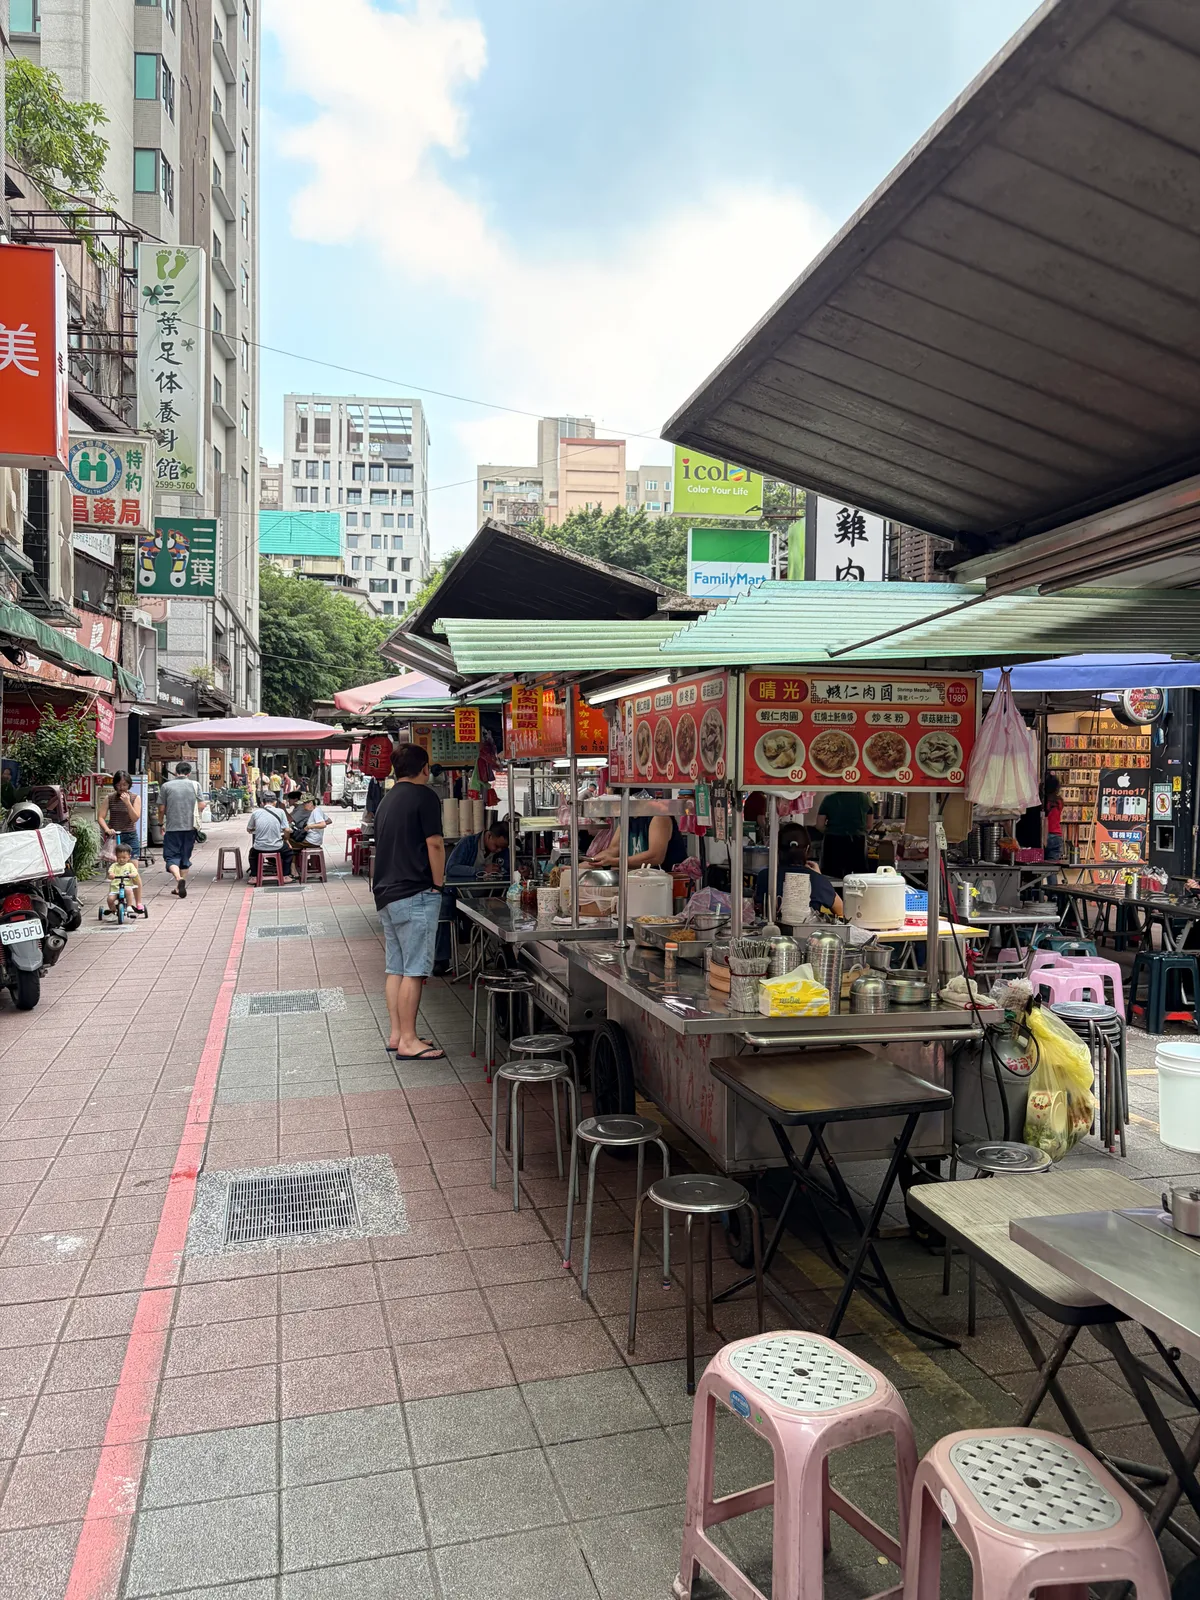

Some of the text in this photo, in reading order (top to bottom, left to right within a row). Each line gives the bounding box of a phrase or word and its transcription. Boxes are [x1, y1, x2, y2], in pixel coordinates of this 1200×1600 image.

[0, 323, 40, 377] 美
[125, 449, 143, 493] 特約
[155, 480, 196, 490] 2599-5760
[687, 484, 749, 496] Color Your Life
[834, 507, 869, 581] 雞肉
[190, 527, 214, 587] 三葉
[694, 571, 767, 588] FamilyMart
[759, 681, 800, 700] 晴光
[948, 694, 967, 703] 1980
[871, 713, 904, 723] 炒冬粉
[790, 769, 803, 780] 60
[844, 770, 857, 781] 80
[898, 770, 911, 781] 50
[949, 771, 962, 781] 80
[1103, 788, 1146, 796] iPhone17
[1100, 842, 1140, 860] 現場
[1, 925, 42, 942] 505-DFU
